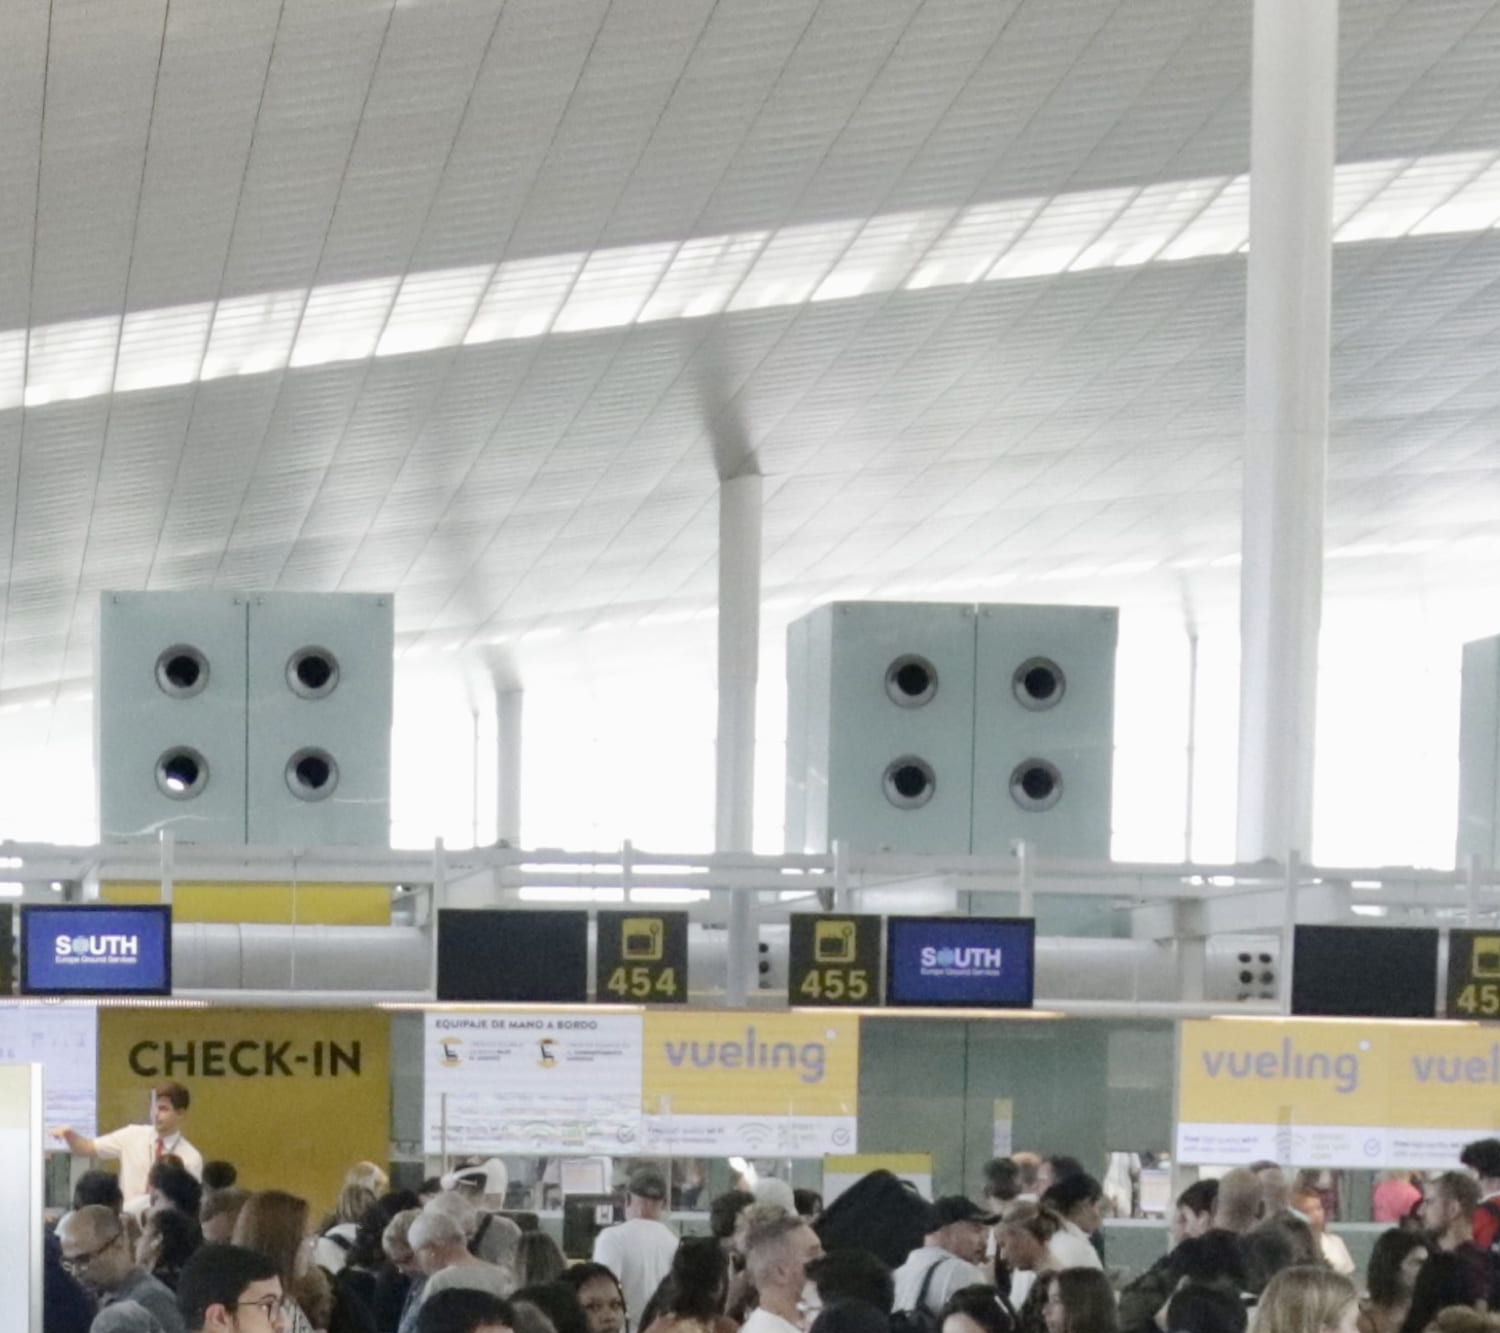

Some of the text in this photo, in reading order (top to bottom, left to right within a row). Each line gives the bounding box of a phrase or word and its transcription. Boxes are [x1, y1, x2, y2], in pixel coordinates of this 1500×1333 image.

[55, 935, 138, 955] SOUTH
[920, 947, 1001, 967] SOUTH
[607, 968, 677, 996] 454
[800, 969, 869, 999] 455
[491, 1019, 505, 1030] DE
[508, 1019, 544, 1030] MANO
[557, 1020, 598, 1030] BORDO
[129, 1040, 361, 1077] CHECK-IN
[664, 1027, 827, 1083] vueling
[1202, 1037, 1360, 1094] vueling
